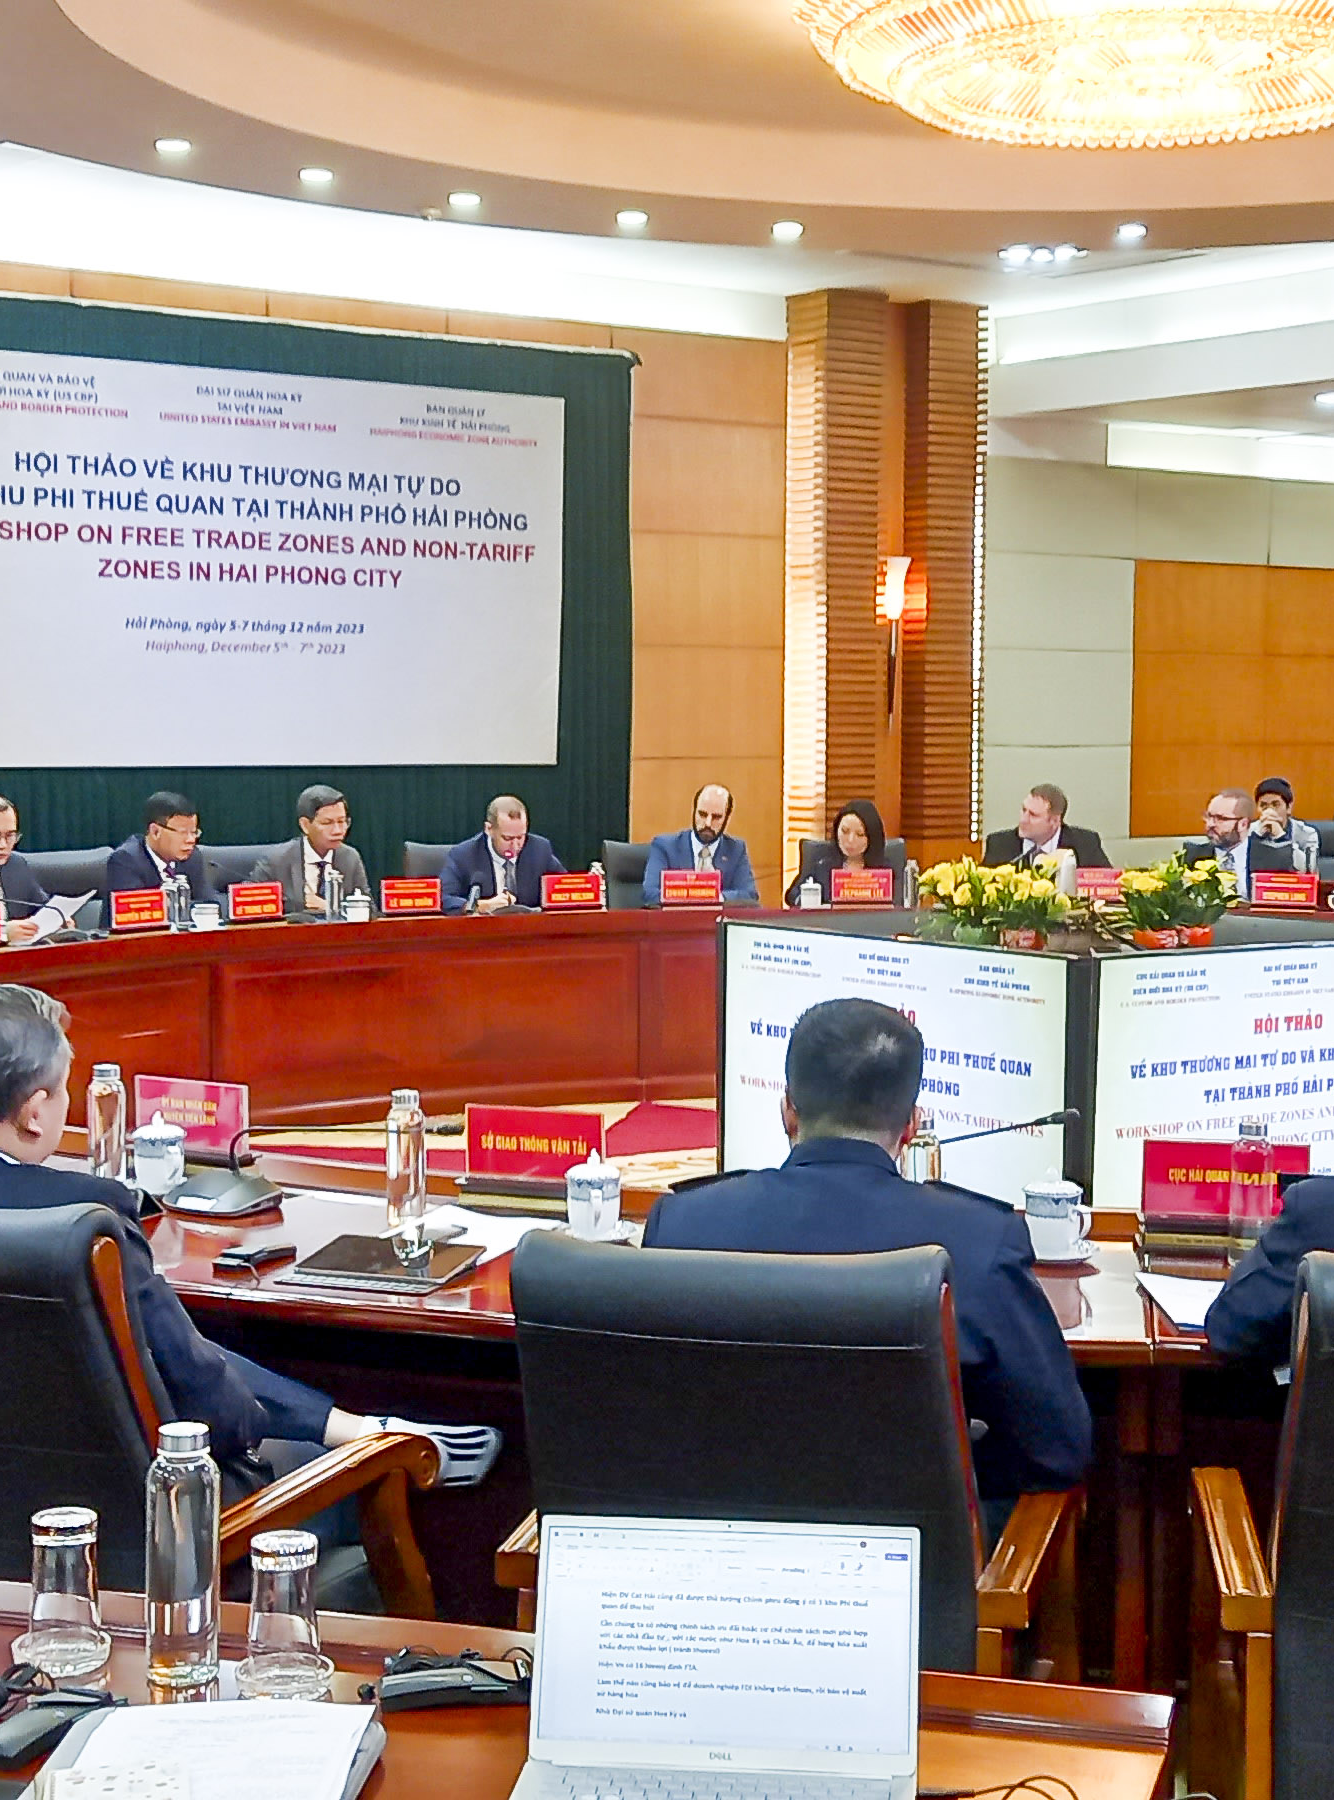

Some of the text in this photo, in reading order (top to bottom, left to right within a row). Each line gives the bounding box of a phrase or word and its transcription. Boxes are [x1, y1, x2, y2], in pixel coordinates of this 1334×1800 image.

[3, 371, 35, 382] QUAN
[9, 386, 32, 398] HOA
[267, 391, 288, 401] HOA
[21, 402, 62, 414] BORDER
[65, 405, 128, 418] PROTECTION
[259, 406, 283, 416] NAM
[427, 404, 445, 414] BAN
[201, 414, 232, 425] STATES
[235, 417, 276, 429] EMBASSY
[314, 423, 337, 433] NAM
[15, 451, 58, 478] HỘI
[67, 451, 137, 478] THẢO
[183, 461, 232, 483] KHU
[239, 464, 342, 489] THƯƠNG
[349, 471, 388, 497] MẠI
[393, 474, 425, 499] TỰ
[431, 477, 461, 497] DO
[33, 487, 74, 509] PHI
[156, 494, 224, 516] QUAN
[233, 498, 269, 523] TẠI
[275, 498, 353, 522] THÀNH
[413, 504, 448, 529] HẢI
[455, 508, 528, 531] PHÒNG
[77, 524, 113, 545] ON
[121, 526, 185, 548] FREE
[192, 528, 272, 551] TRADE
[278, 533, 354, 555] ZONES
[361, 537, 407, 557] AND
[413, 540, 536, 563] NON-TARIFF
[98, 558, 403, 589] ZONES IN HAI PHONG CITY
[125, 616, 147, 630] Hải
[196, 619, 226, 635] ngày
[251, 620, 287, 635] tháng
[289, 621, 304, 633] 12
[307, 621, 333, 634] năm
[335, 622, 365, 635] 2023
[145, 640, 208, 655] Haiphong,
[211, 641, 272, 654] December
[317, 642, 346, 655] 2023
[1284, 1008, 1323, 1032] THẢO
[767, 1023, 787, 1039] KHU
[940, 1050, 960, 1067] PHI
[963, 1052, 997, 1072] THUẾ
[1001, 1058, 1032, 1077] QUAN
[1151, 1060, 1177, 1078] KHU
[1181, 1055, 1231, 1074] THƯƠNG
[1235, 1054, 1257, 1073] MẠI
[1261, 1050, 1279, 1070] TỰ
[1281, 1051, 1297, 1066] DO
[1300, 1045, 1315, 1064] VÀ
[921, 1076, 960, 1097] PHÒNG
[1204, 1088, 1226, 1106] TẠI
[1230, 1082, 1271, 1101] THÀNH
[1275, 1076, 1299, 1097] PHỐ
[1303, 1074, 1324, 1094] HẢI
[1115, 1122, 1184, 1140] WORKSHOP
[1187, 1120, 1203, 1133] ON
[1207, 1116, 1235, 1130] FREE
[1280, 1108, 1315, 1123] ZONES
[481, 1130, 587, 1158] SỞ GIAO THÔNG VẬN TẢI
[1168, 1168, 1186, 1185] CỤC
[1189, 1164, 1203, 1182] HẢI
[1205, 1168, 1229, 1183] QUAN
[709, 1751, 732, 1761] DELL
